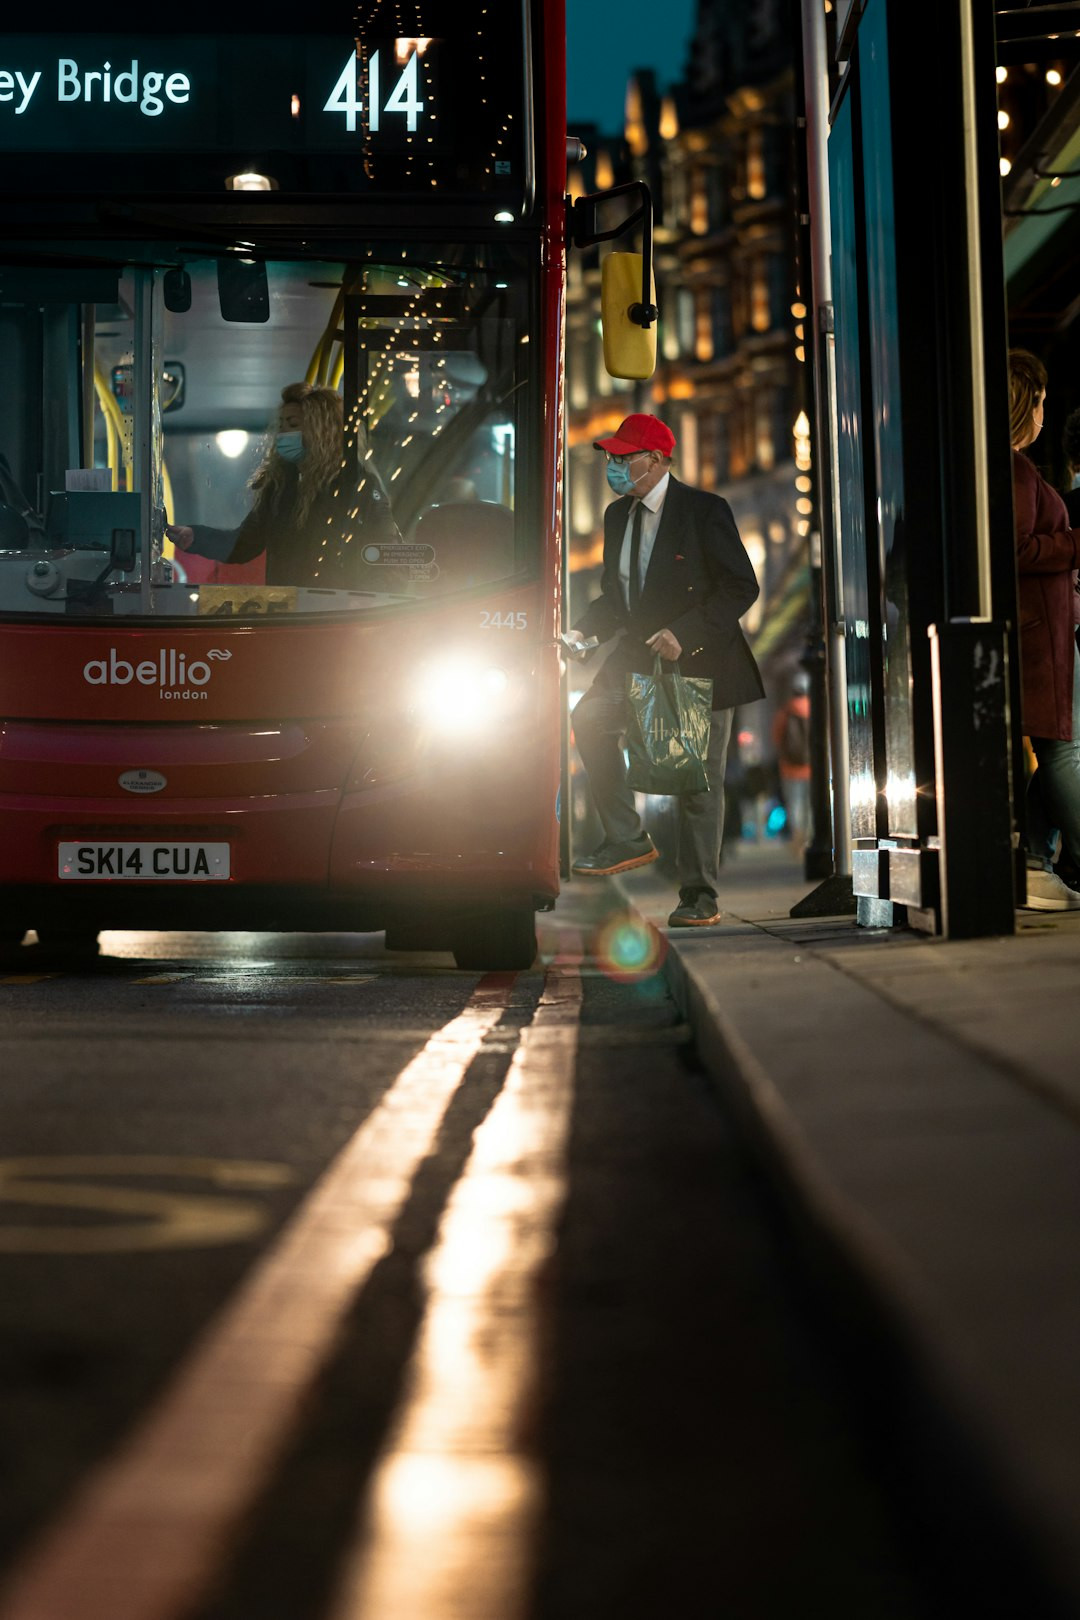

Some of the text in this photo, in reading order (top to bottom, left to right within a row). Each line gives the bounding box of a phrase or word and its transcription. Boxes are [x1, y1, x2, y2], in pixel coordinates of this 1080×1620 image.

[58, 59, 191, 117] Bridge
[322, 49, 424, 132] 414
[479, 611, 528, 630] 2445
[83, 648, 211, 687] abellio
[159, 689, 208, 700] london
[77, 848, 210, 874] SK14 CUA
